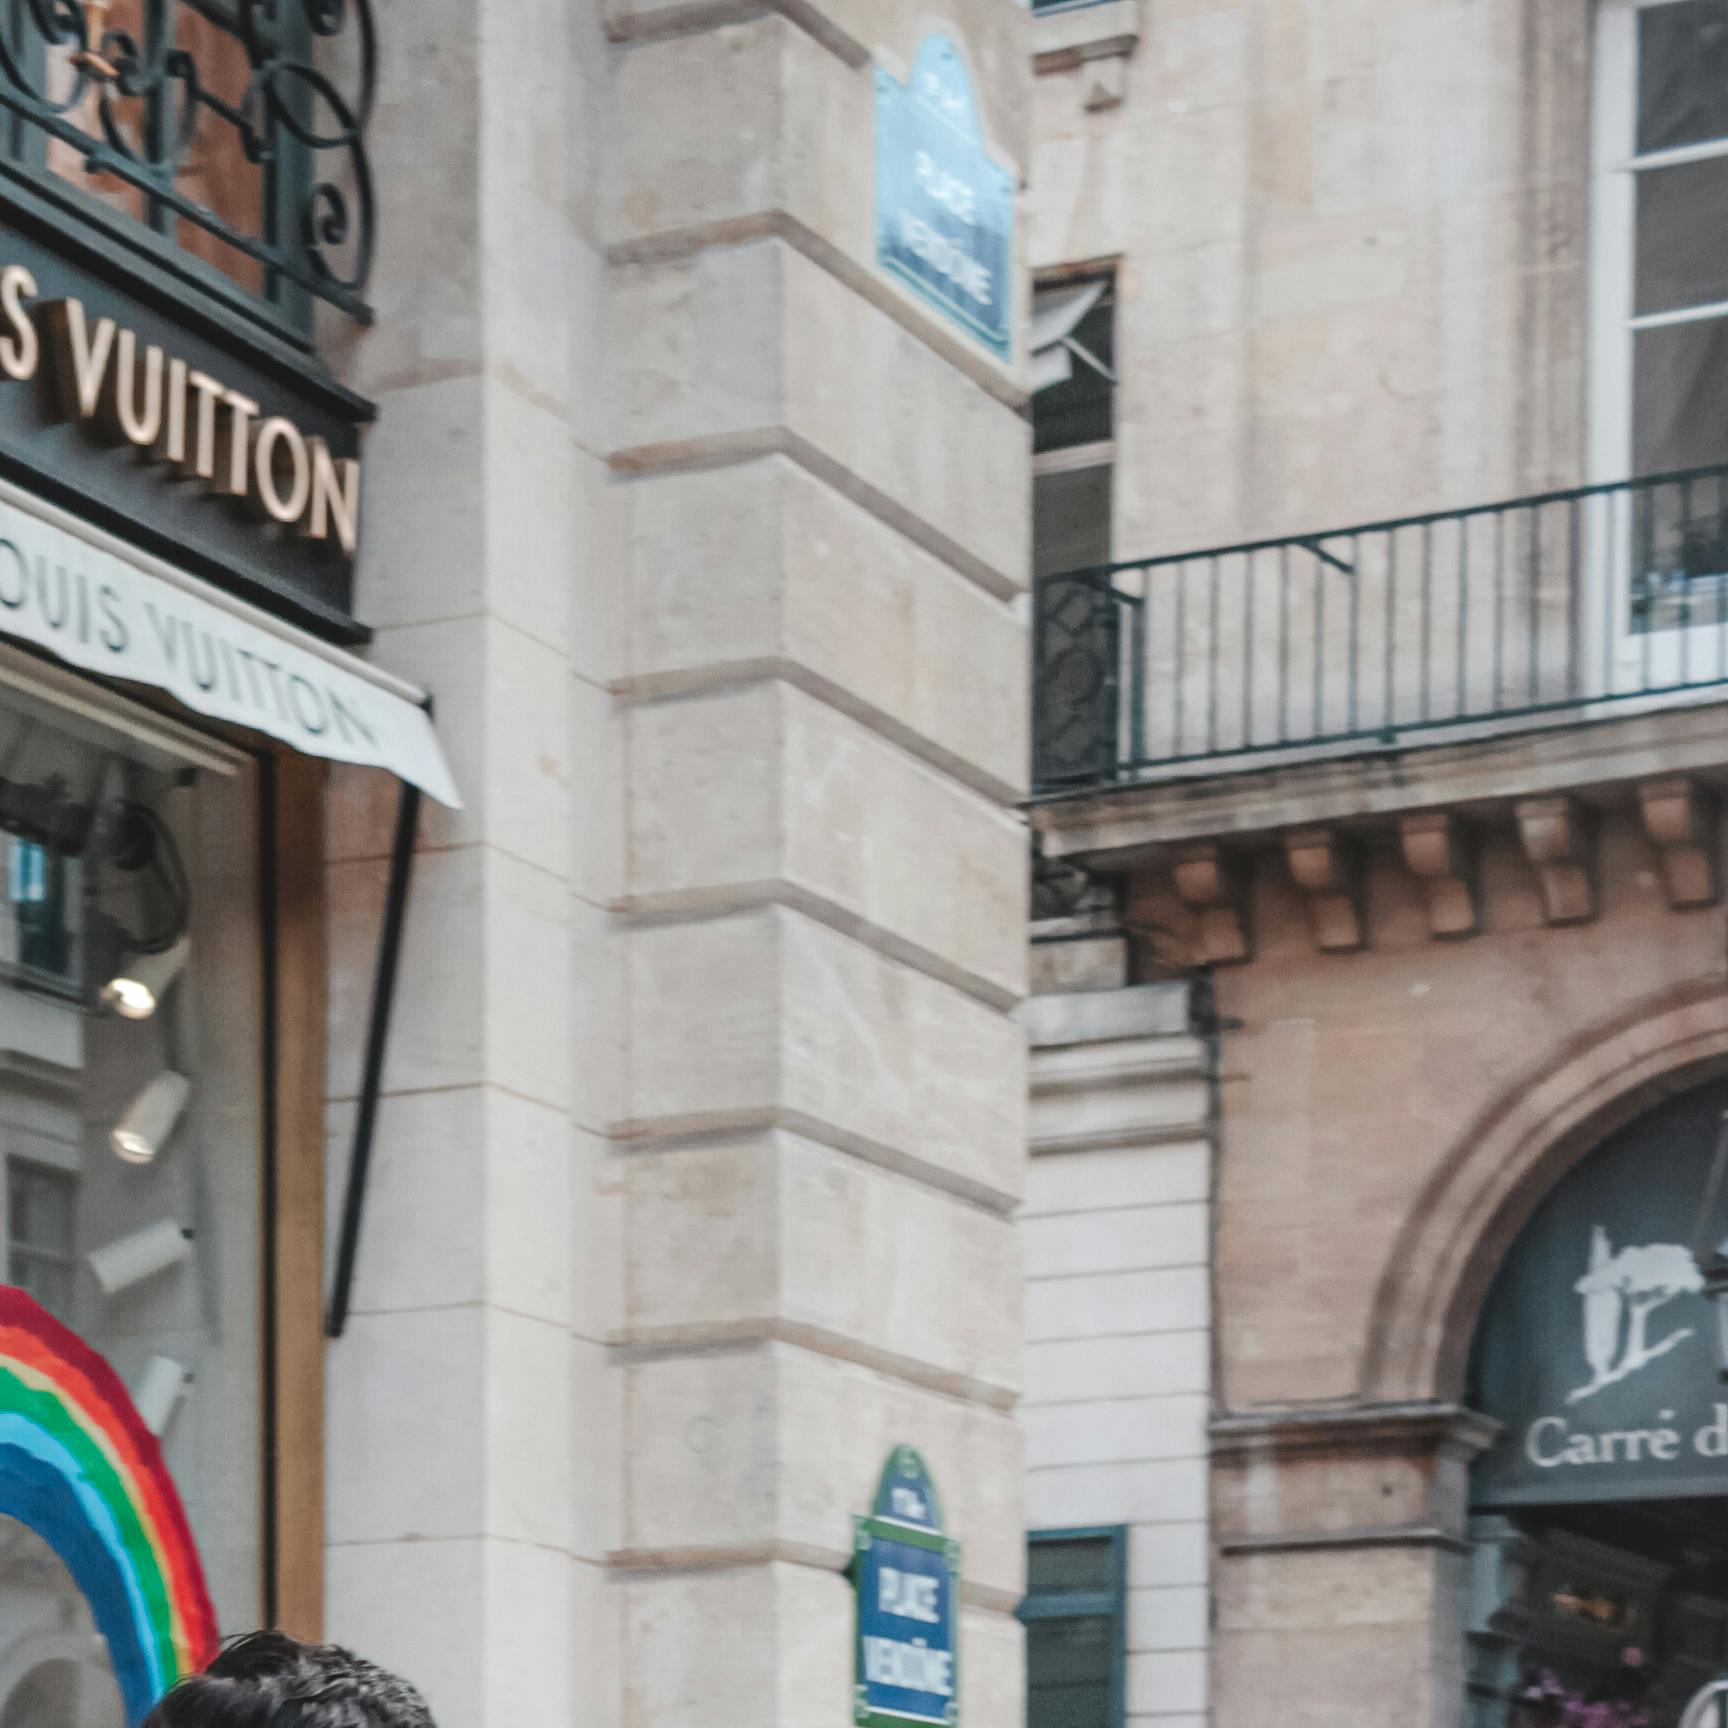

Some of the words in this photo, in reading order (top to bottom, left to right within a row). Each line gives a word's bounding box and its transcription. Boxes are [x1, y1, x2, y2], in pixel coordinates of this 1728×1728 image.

[66, 297, 360, 558] VUITTON
[143, 602, 379, 748] VUITTON
[1526, 1408, 1681, 1468] Carré
